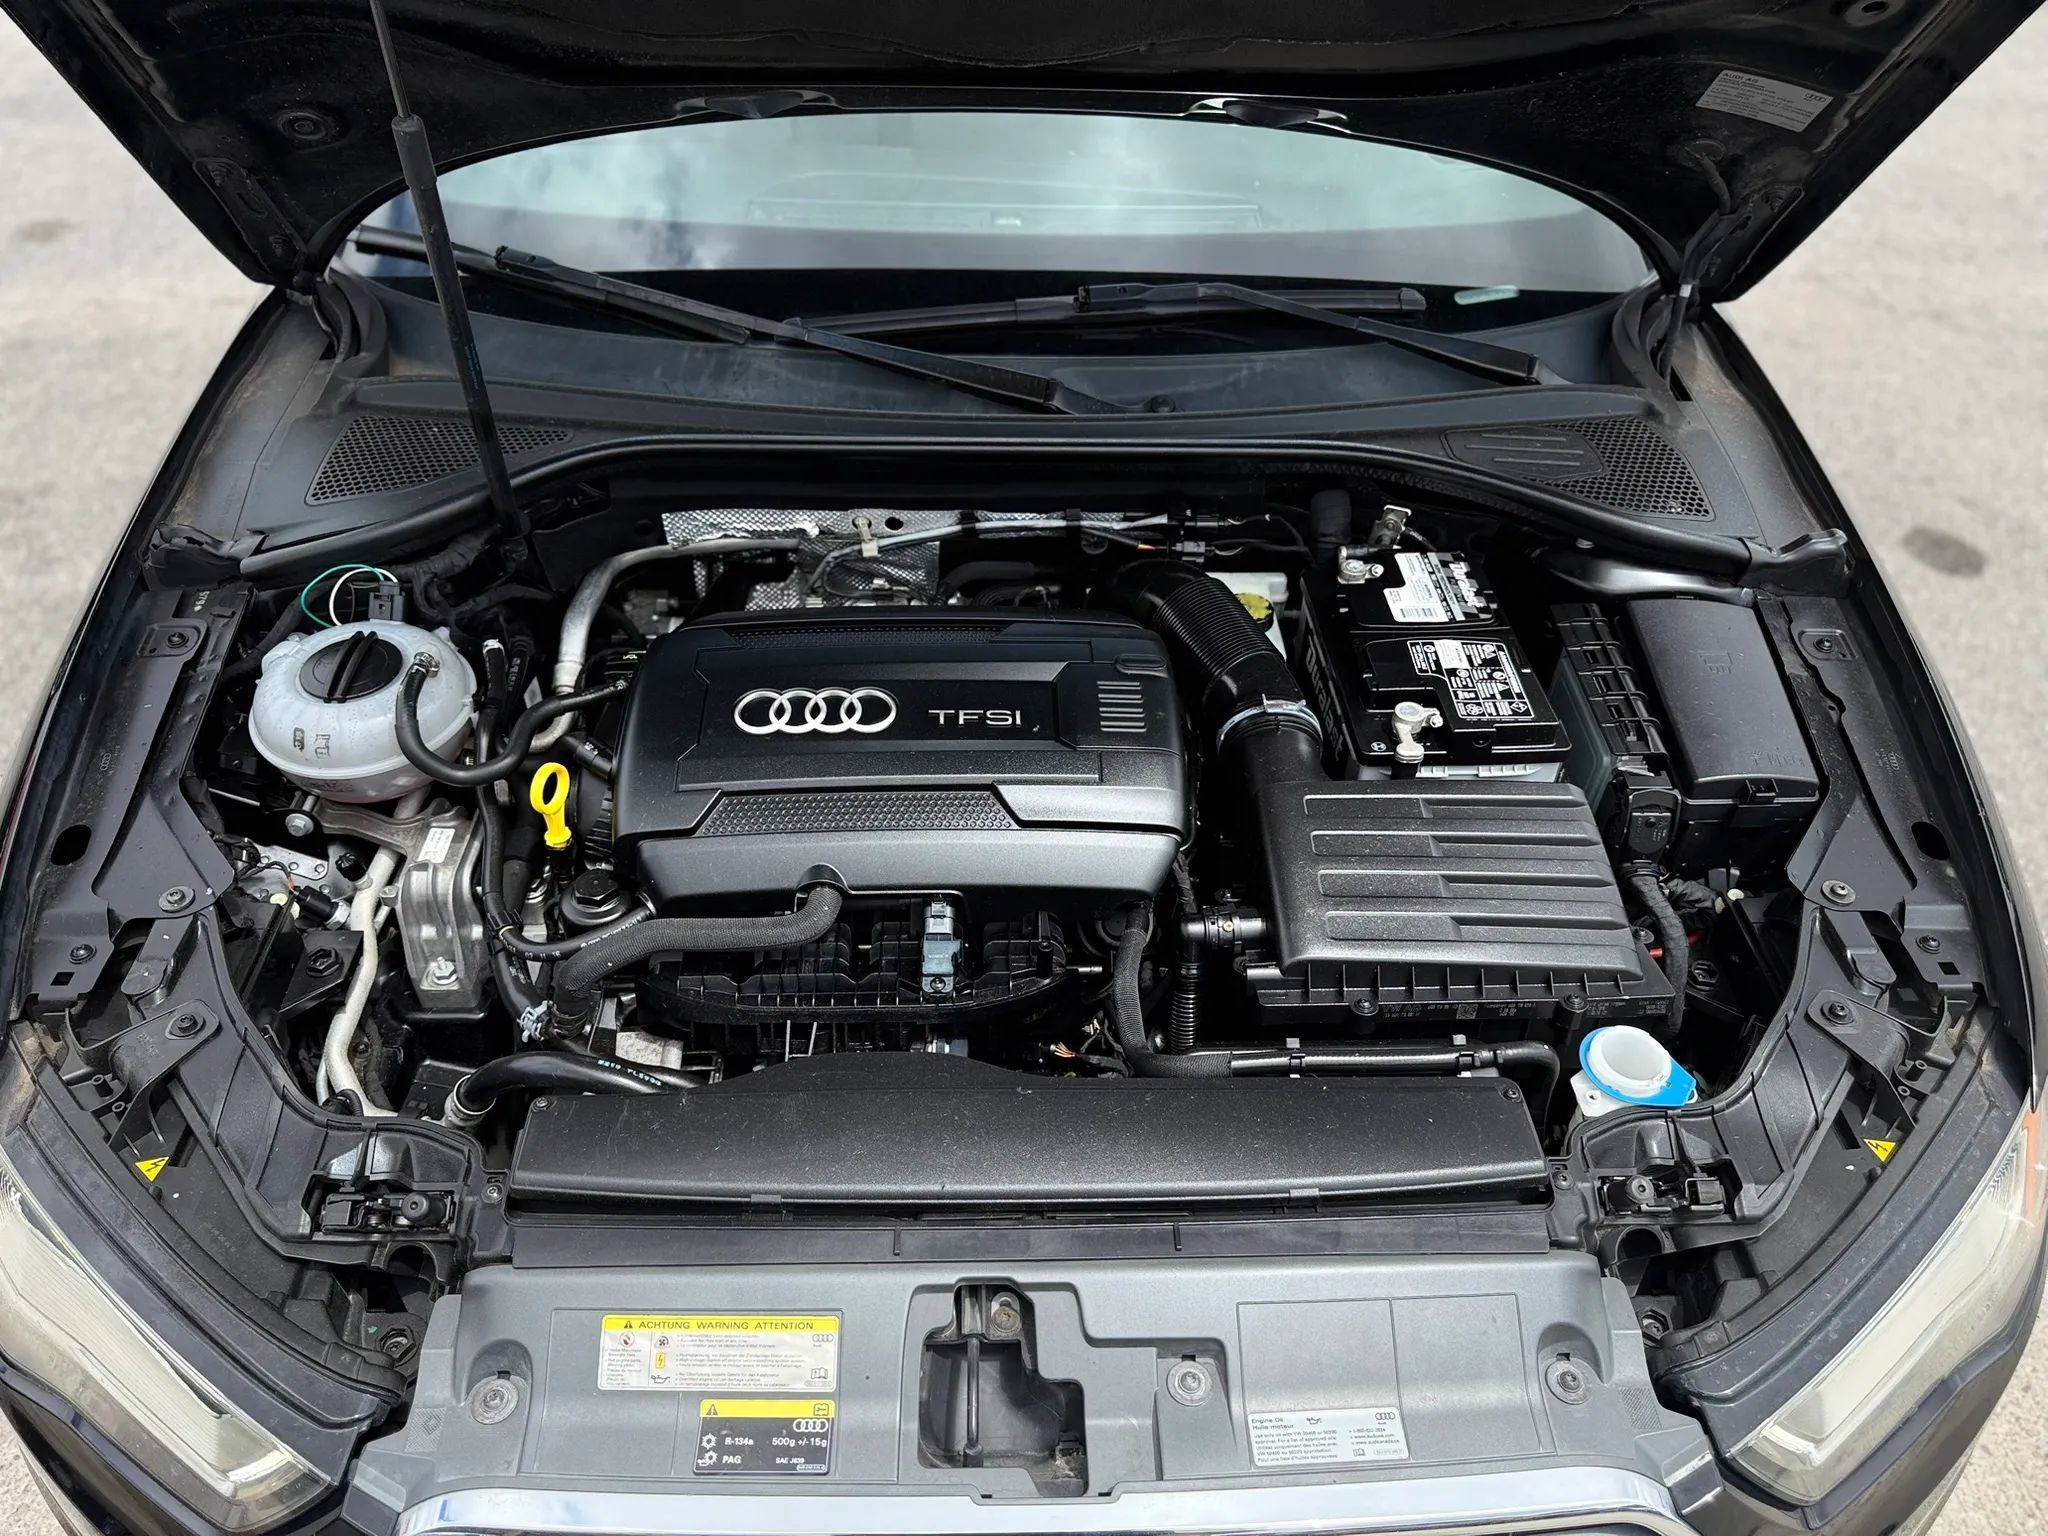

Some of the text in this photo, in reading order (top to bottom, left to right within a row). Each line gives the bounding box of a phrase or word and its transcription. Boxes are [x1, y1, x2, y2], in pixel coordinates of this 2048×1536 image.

[1722, 72, 1743, 81] AUDI
[1449, 561, 1484, 608] Duralast
[1306, 647, 1343, 762] Duralast
[928, 709, 1022, 727] TFSI
[639, 1322, 814, 1330] ACHTUNG WARNING ATTENTION
[724, 1437, 754, 1446] R-134a
[772, 1437, 795, 1447] 500g
[722, 1455, 742, 1464] PAG
